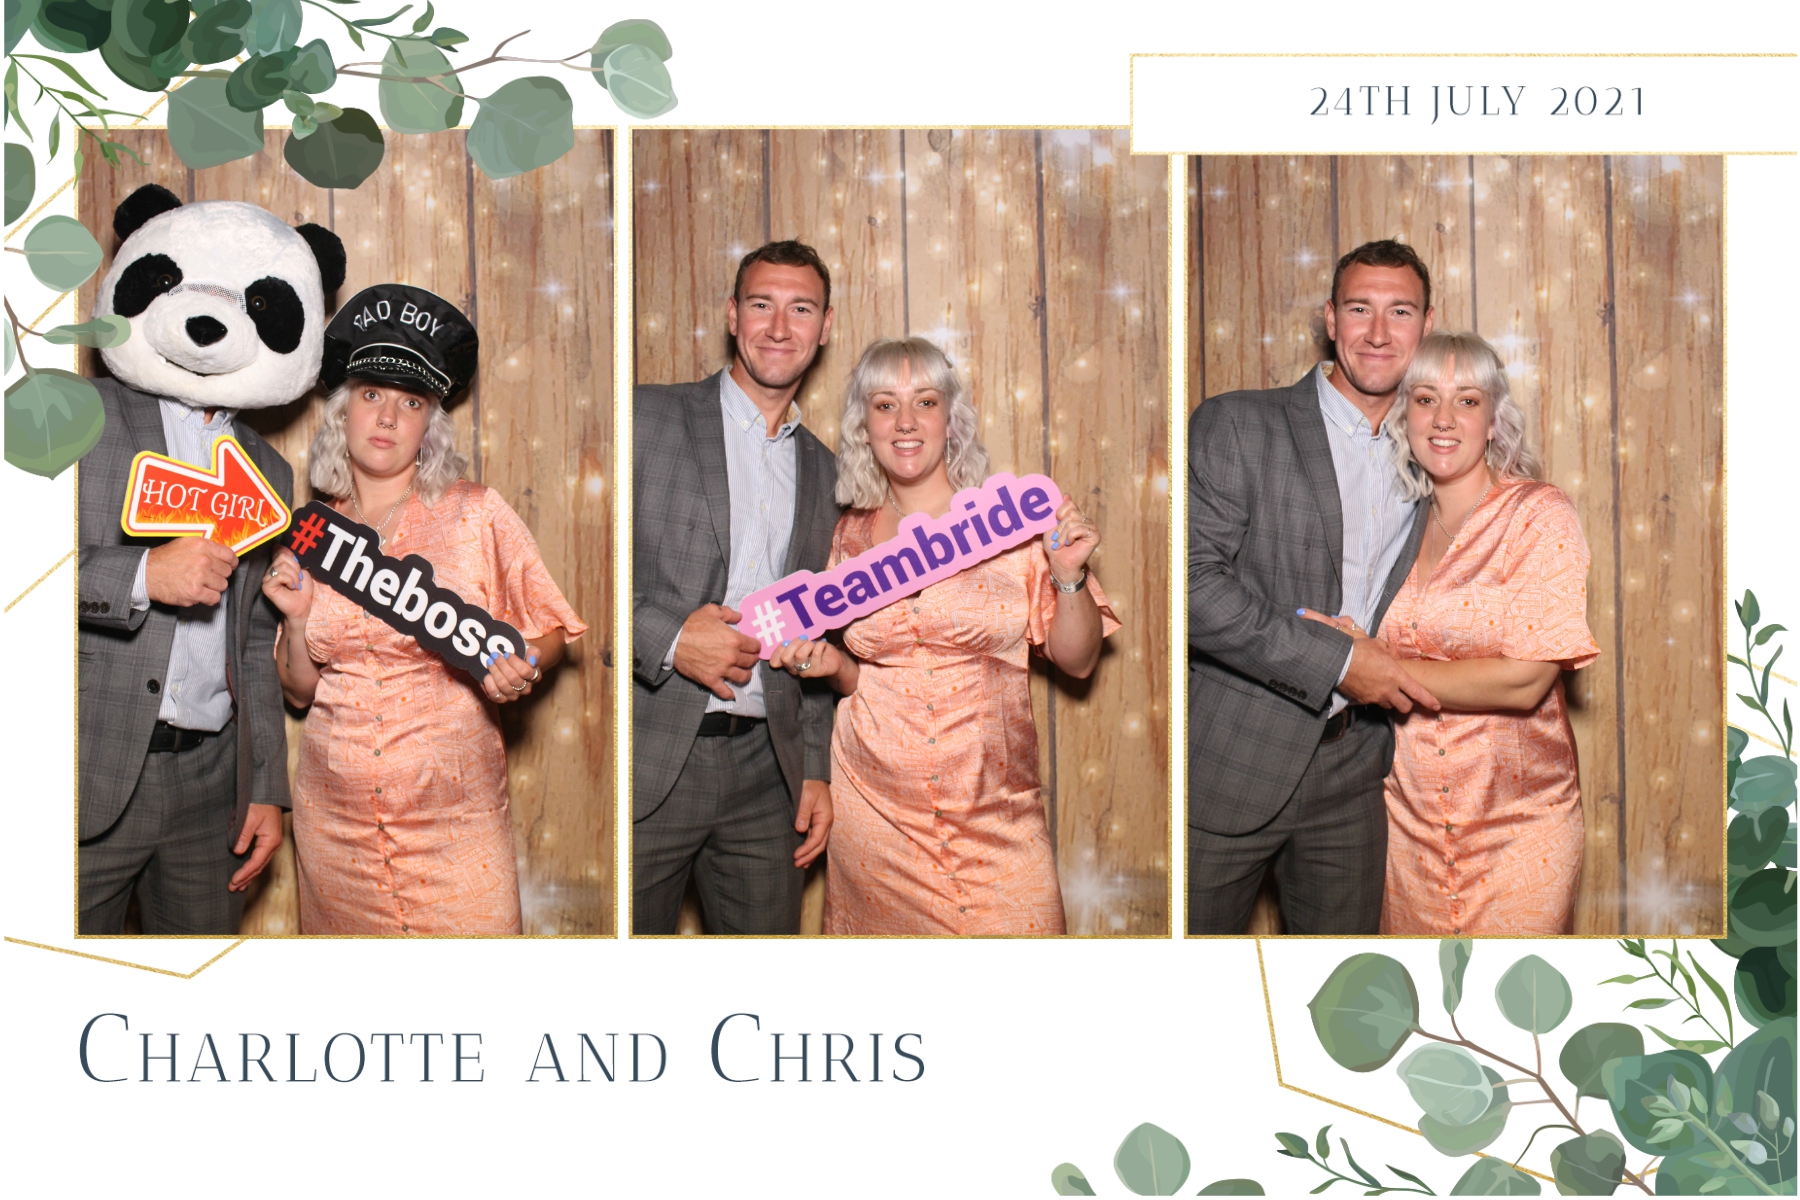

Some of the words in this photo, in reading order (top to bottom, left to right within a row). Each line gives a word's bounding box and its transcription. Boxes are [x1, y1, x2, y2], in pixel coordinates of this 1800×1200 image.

[400, 302, 444, 337] BOY
[142, 478, 208, 512] HOT
[210, 490, 267, 528] GIRL
[751, 484, 1054, 648] #Teambride
